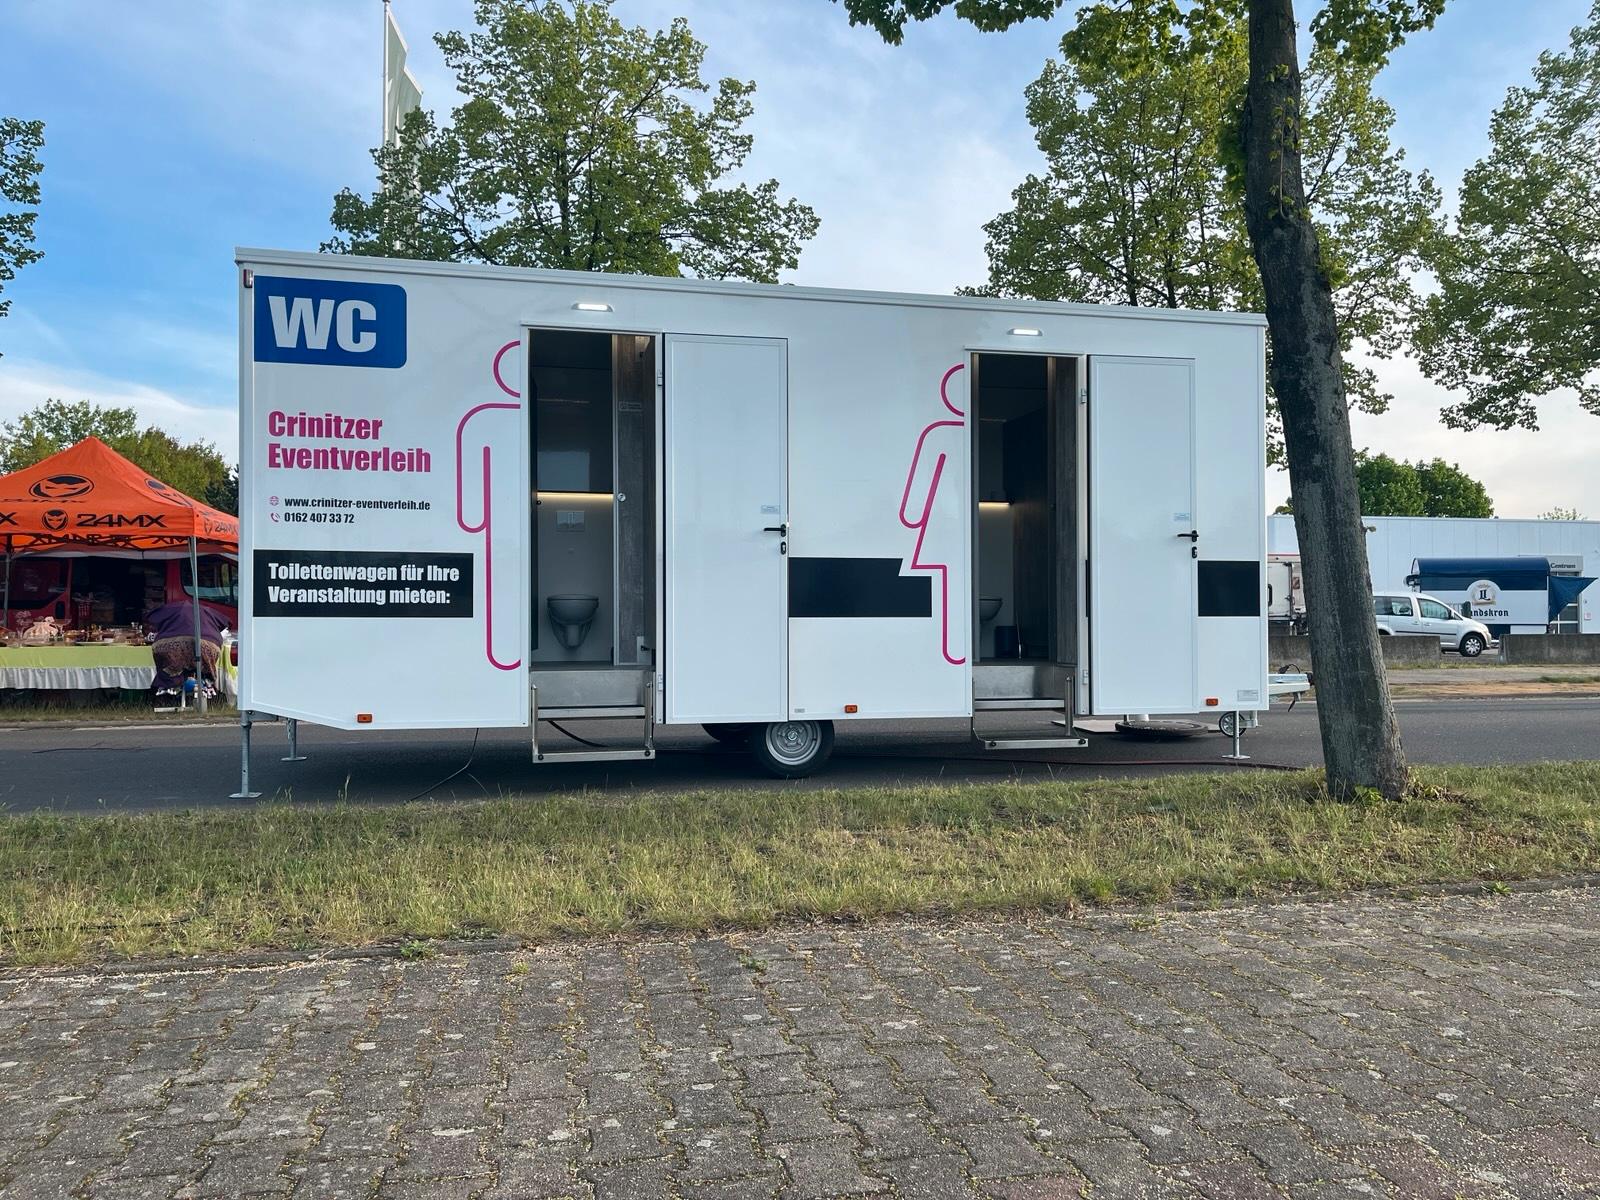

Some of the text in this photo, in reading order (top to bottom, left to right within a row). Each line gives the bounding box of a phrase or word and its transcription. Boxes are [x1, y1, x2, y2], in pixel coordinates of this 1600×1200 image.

[268, 295, 377, 353] WC
[268, 411, 383, 440] Crinitzer
[268, 443, 431, 473] Eventverleih
[284, 497, 431, 511] www.crinitzer-eventverleih.de
[76, 513, 168, 528] 24MX
[284, 512, 355, 524] 0162 407 33 72
[268, 563, 460, 582] Toilettenwagen für Ihre
[268, 586, 451, 606] Veranstaltung mieten:
